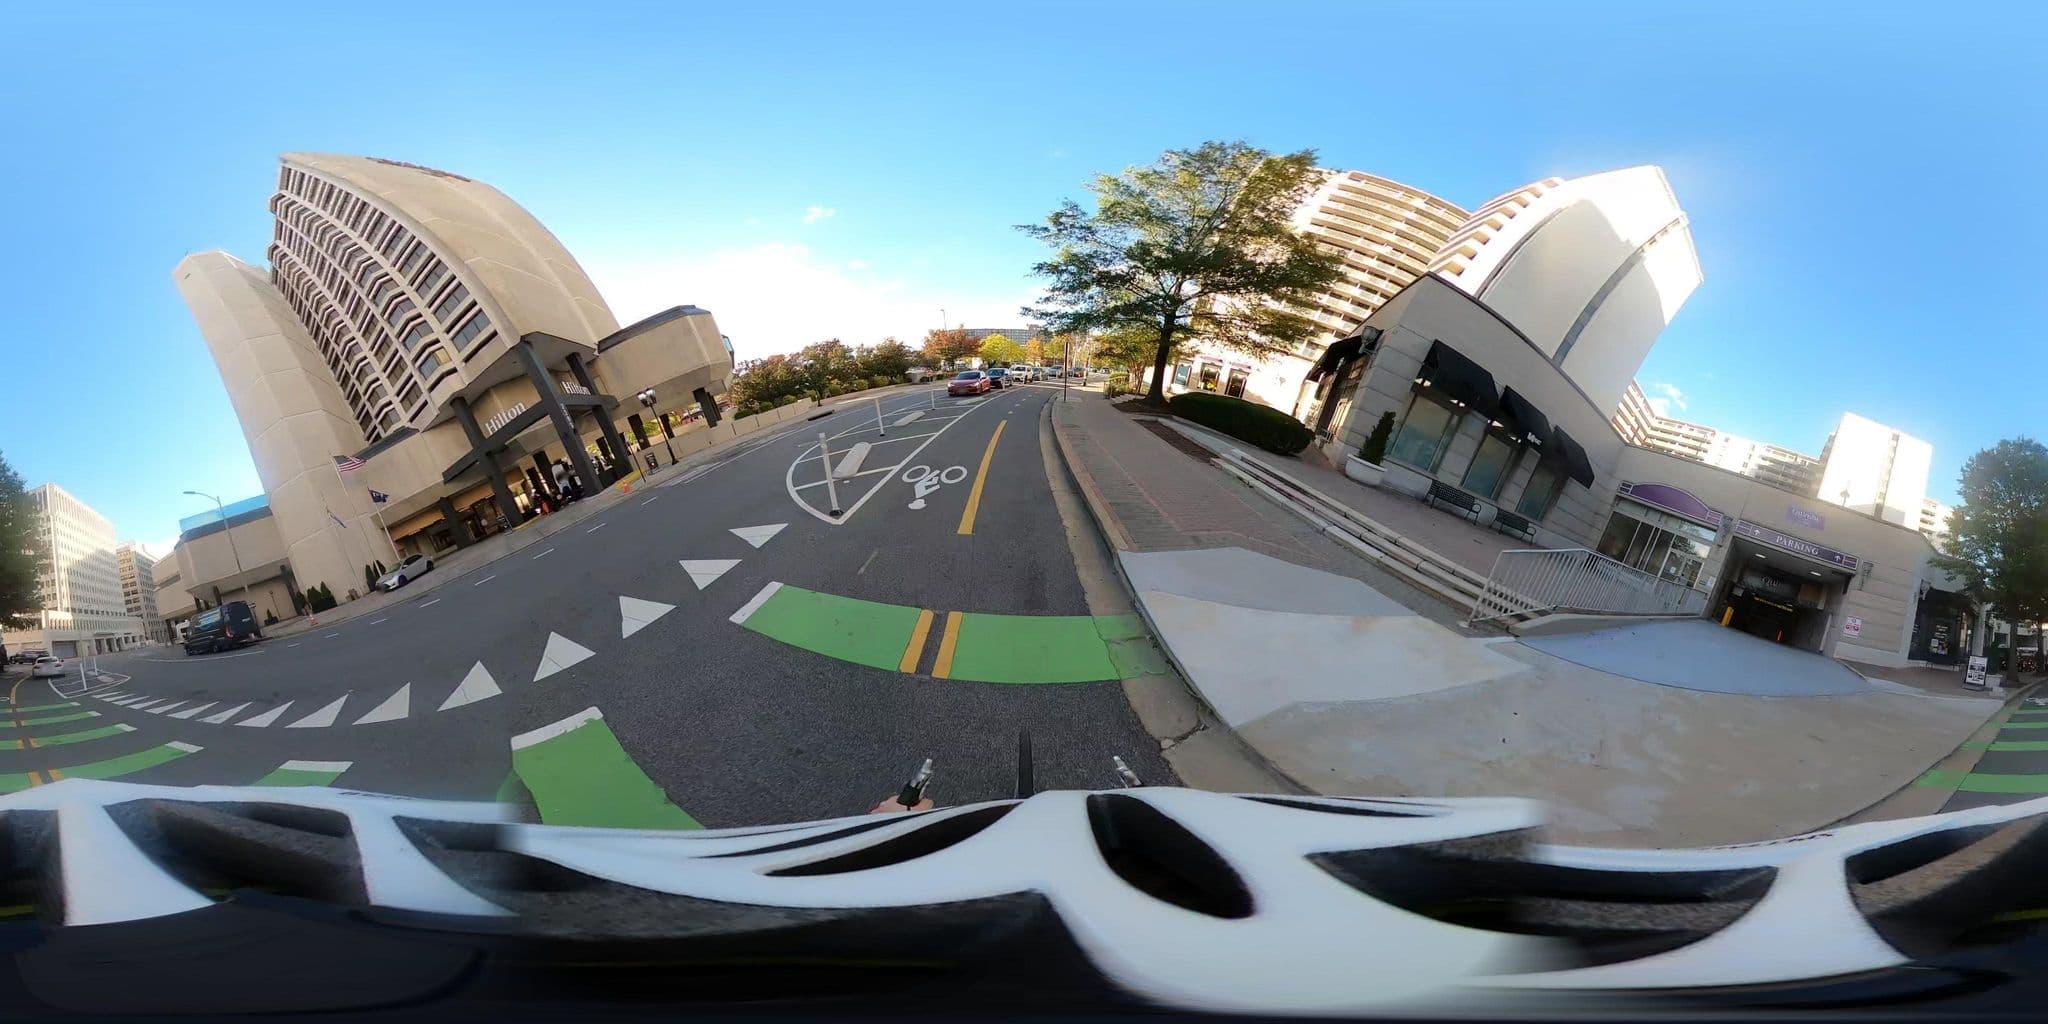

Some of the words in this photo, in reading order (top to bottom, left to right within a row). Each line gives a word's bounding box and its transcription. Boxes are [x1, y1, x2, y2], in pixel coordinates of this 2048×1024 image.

[561, 381, 591, 396] Hilton
[484, 402, 526, 436] Hilton
[1776, 535, 1820, 555] PARKING
